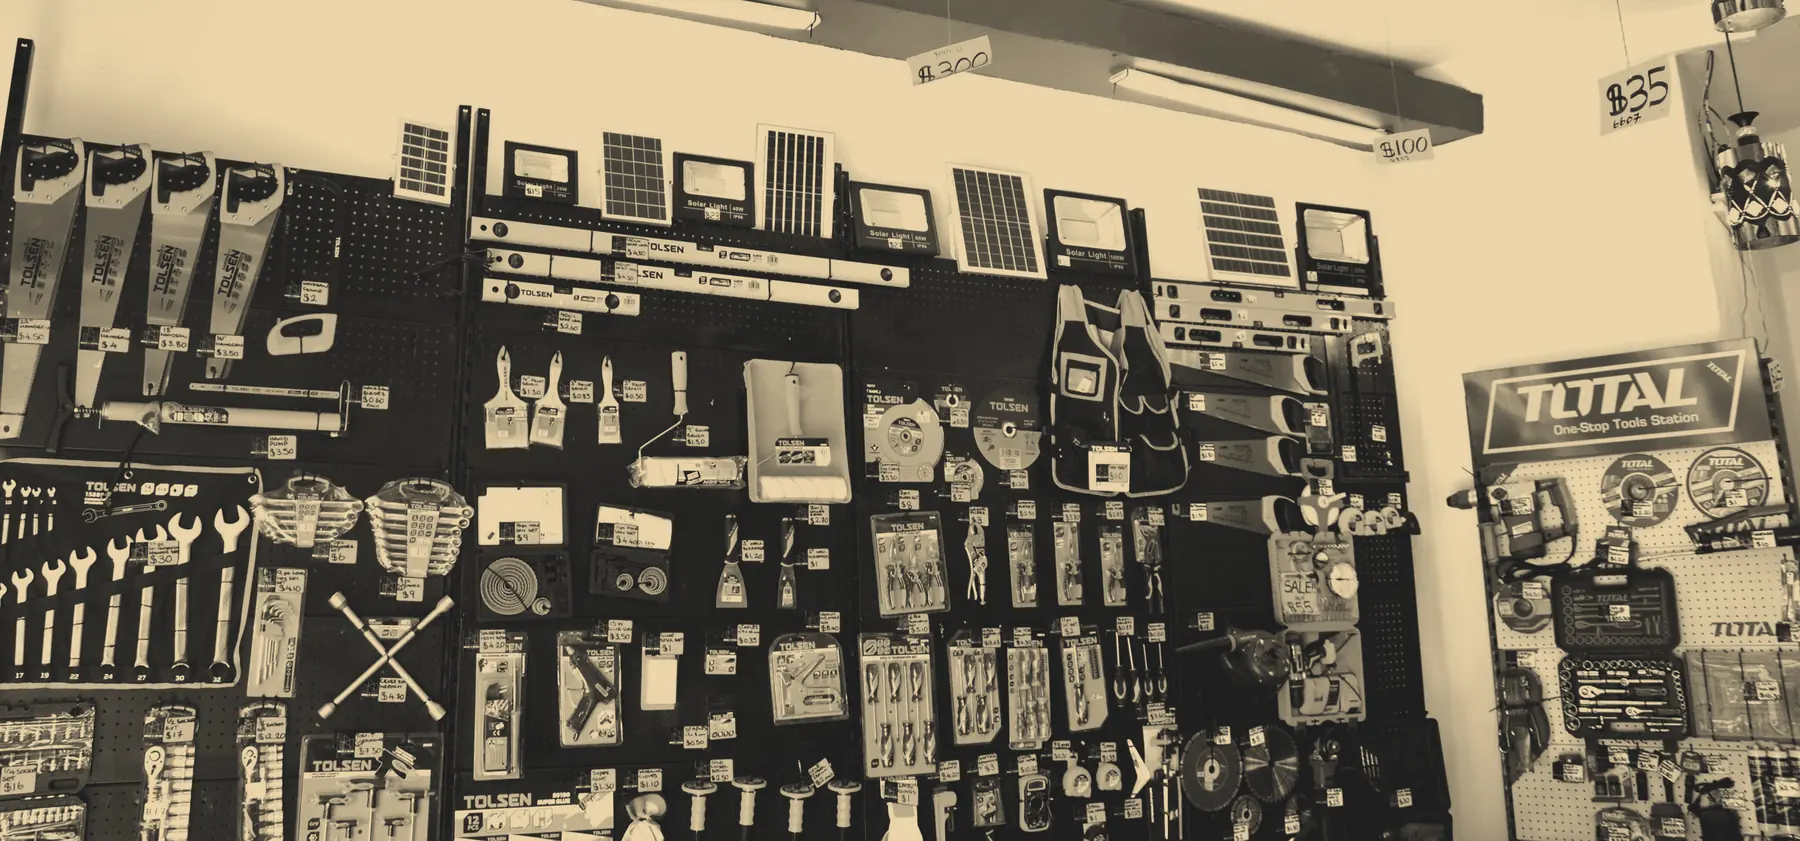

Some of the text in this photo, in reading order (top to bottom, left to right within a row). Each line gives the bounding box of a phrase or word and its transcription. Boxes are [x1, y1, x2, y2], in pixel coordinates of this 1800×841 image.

[1607, 66, 1668, 117] $35
[1380, 137, 1428, 159] $100
[709, 202, 728, 211] Light
[869, 229, 888, 238] Solar
[891, 232, 910, 241] Light
[649, 243, 684, 254] OLSEN
[91, 235, 111, 283] TOLSEN
[1066, 248, 1085, 257] Solar
[1088, 250, 1107, 261] Light
[20, 237, 41, 286] TOLSEN
[153, 245, 174, 292] TOLSEN
[217, 249, 240, 294] TOLSEN
[521, 289, 552, 298] TOLSEN
[1706, 361, 1733, 383] TOTAL
[867, 394, 904, 404] TOLSEN
[1517, 368, 1698, 422] TOTAL
[989, 401, 1029, 413] TOLSEN
[1553, 412, 1699, 436] One-Stop Tools Station
[270, 448, 293, 457] $3.50
[1621, 459, 1654, 468] TOTAL
[1708, 458, 1744, 467] TOTAL
[86, 481, 136, 493] TOLSEN
[891, 522, 924, 532] TOLSEN
[149, 555, 173, 564] $30
[1597, 594, 1629, 602] TOTAL
[1712, 621, 1776, 637] TOTA
[780, 641, 816, 651] TOLSEN
[1066, 637, 1098, 647] TOLSEN
[891, 645, 930, 654] TOLSEN
[166, 730, 184, 739] $17
[312, 760, 372, 772] TOLSEN
[4, 783, 24, 793] $16
[464, 792, 532, 809] TOLSEN
[467, 815, 480, 824] 12
